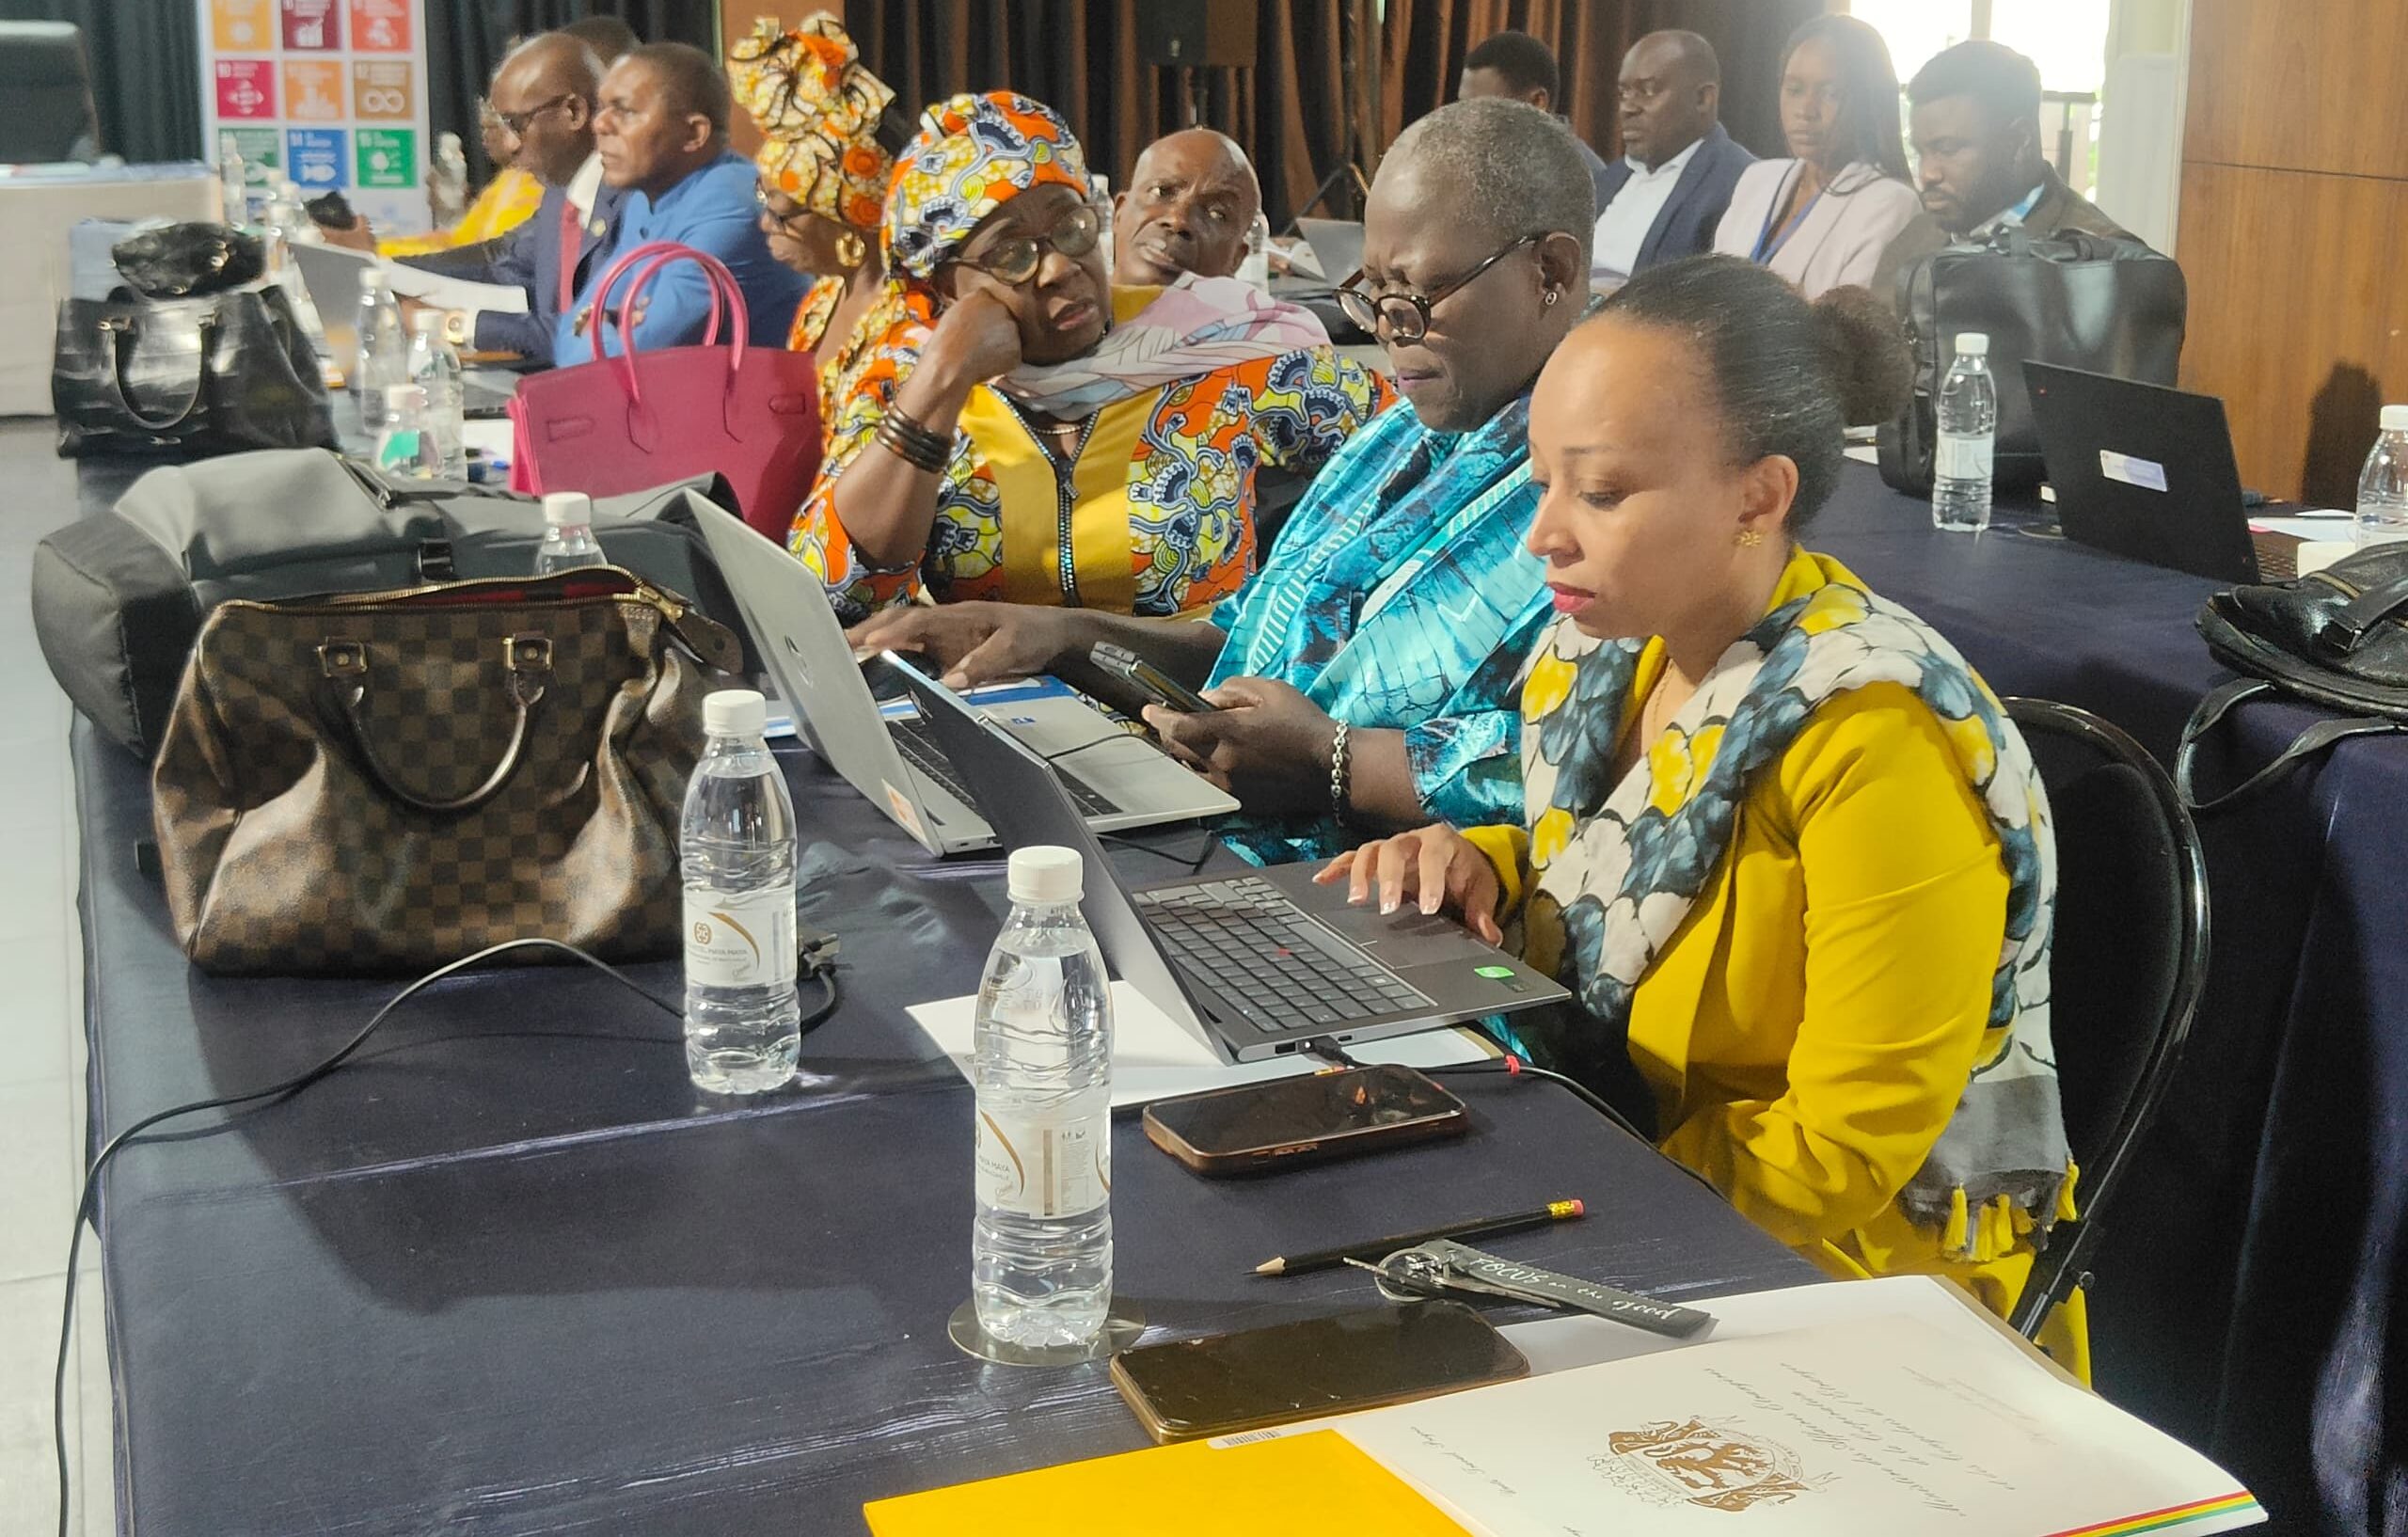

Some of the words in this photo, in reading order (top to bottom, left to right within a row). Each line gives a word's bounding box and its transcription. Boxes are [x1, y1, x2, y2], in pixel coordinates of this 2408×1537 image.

[1469, 1257, 1550, 1284] FOCUS
[1576, 1287, 1604, 1300] the
[1611, 1300, 1684, 1321] good
